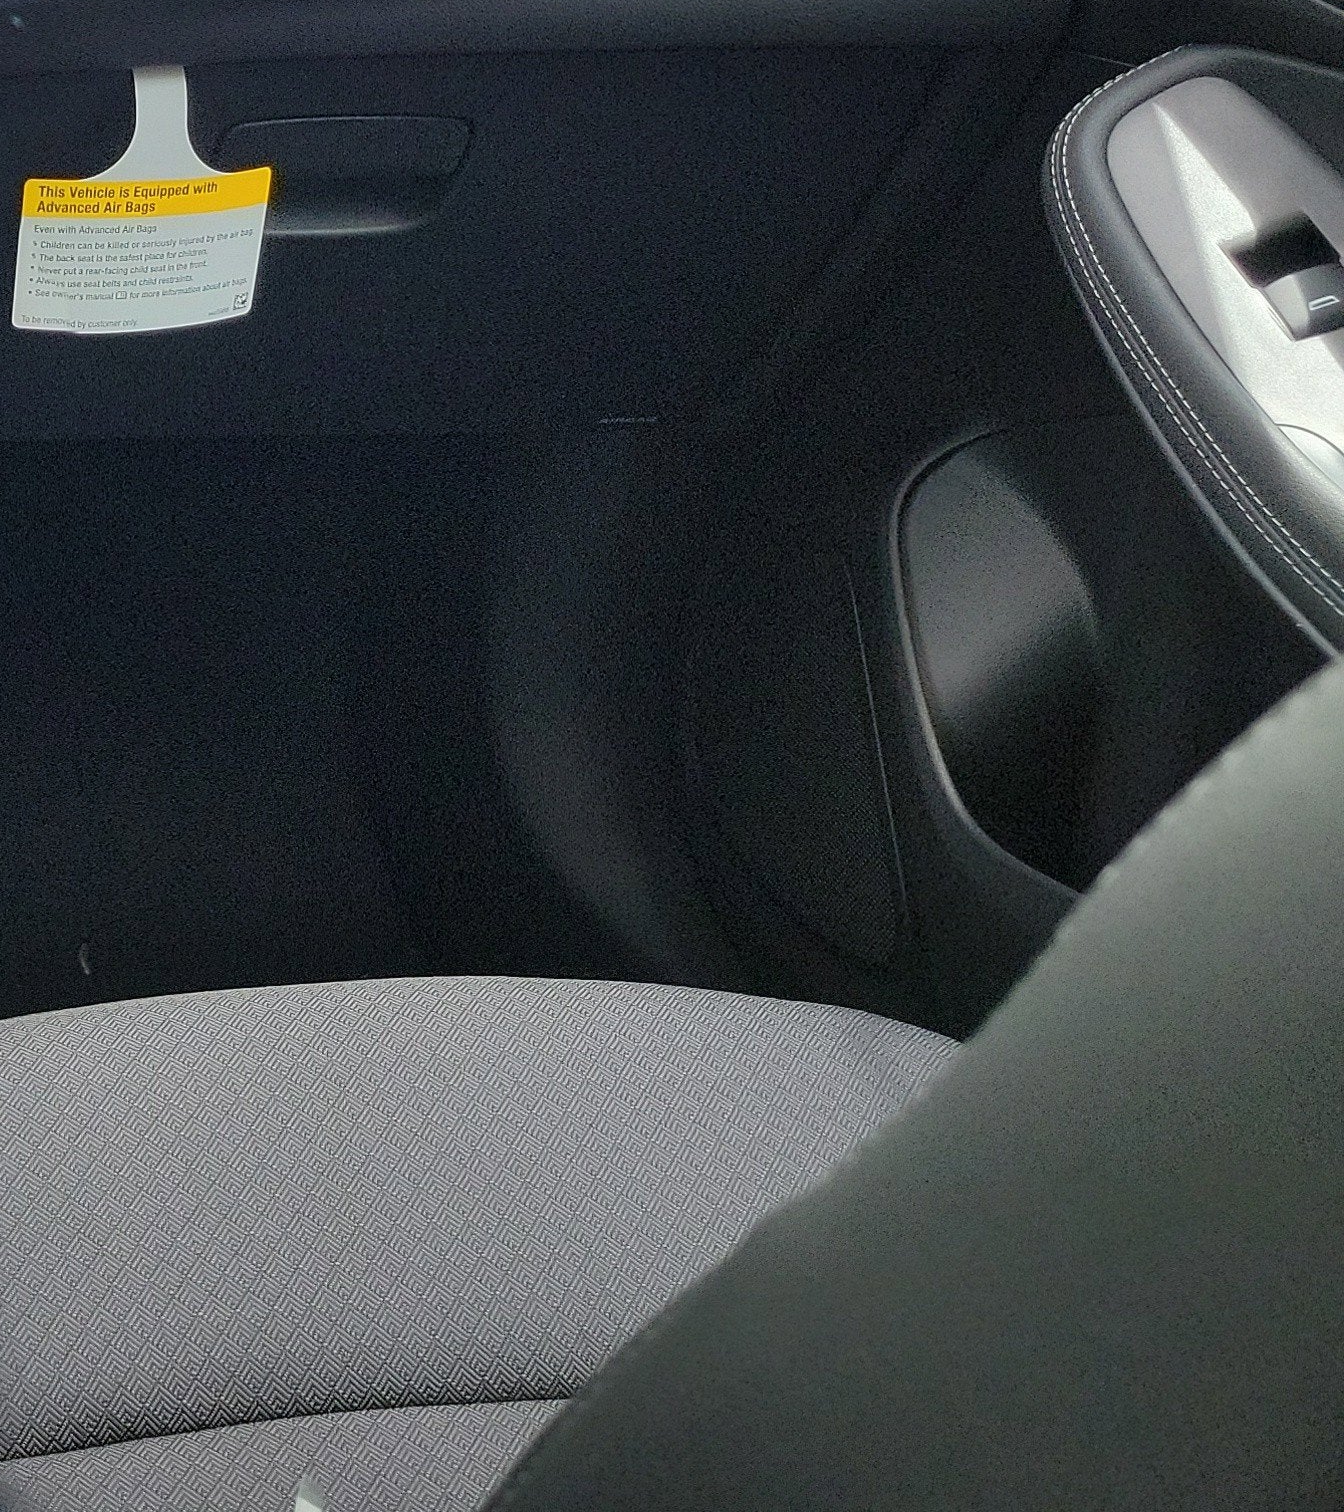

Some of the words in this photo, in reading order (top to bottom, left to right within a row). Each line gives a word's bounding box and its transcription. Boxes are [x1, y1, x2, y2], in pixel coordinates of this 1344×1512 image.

[39, 185, 65, 198] This
[69, 186, 115, 199] Vehicle
[120, 185, 130, 198] is
[133, 184, 189, 200] Equipped
[193, 181, 218, 195] with
[37, 200, 100, 214] Advanced
[103, 201, 122, 213] Air
[125, 201, 156, 215] Bags
[34, 225, 55, 234] Even
[58, 225, 76, 234] with
[79, 225, 120, 234] Advanced
[122, 225, 134, 234] Air
[136, 225, 157, 235] Bags
[40, 240, 75, 249] Children
[94, 241, 105, 249] be
[107, 240, 129, 249] killed
[142, 238, 177, 248] seriously
[39, 254, 54, 262] The
[56, 253, 75, 262] back
[77, 254, 94, 263] seat
[105, 253, 118, 262] the
[119, 253, 142, 262] safest
[63, 267, 76, 276] put
[85, 266, 128, 276] rear-facing
[67, 280, 82, 288] use
[83, 279, 100, 288] seat
[102, 278, 121, 288] belts
[123, 278, 137, 286] and
[21, 314, 30, 323] To
[32, 315, 42, 324] be
[77, 320, 86, 329] by
